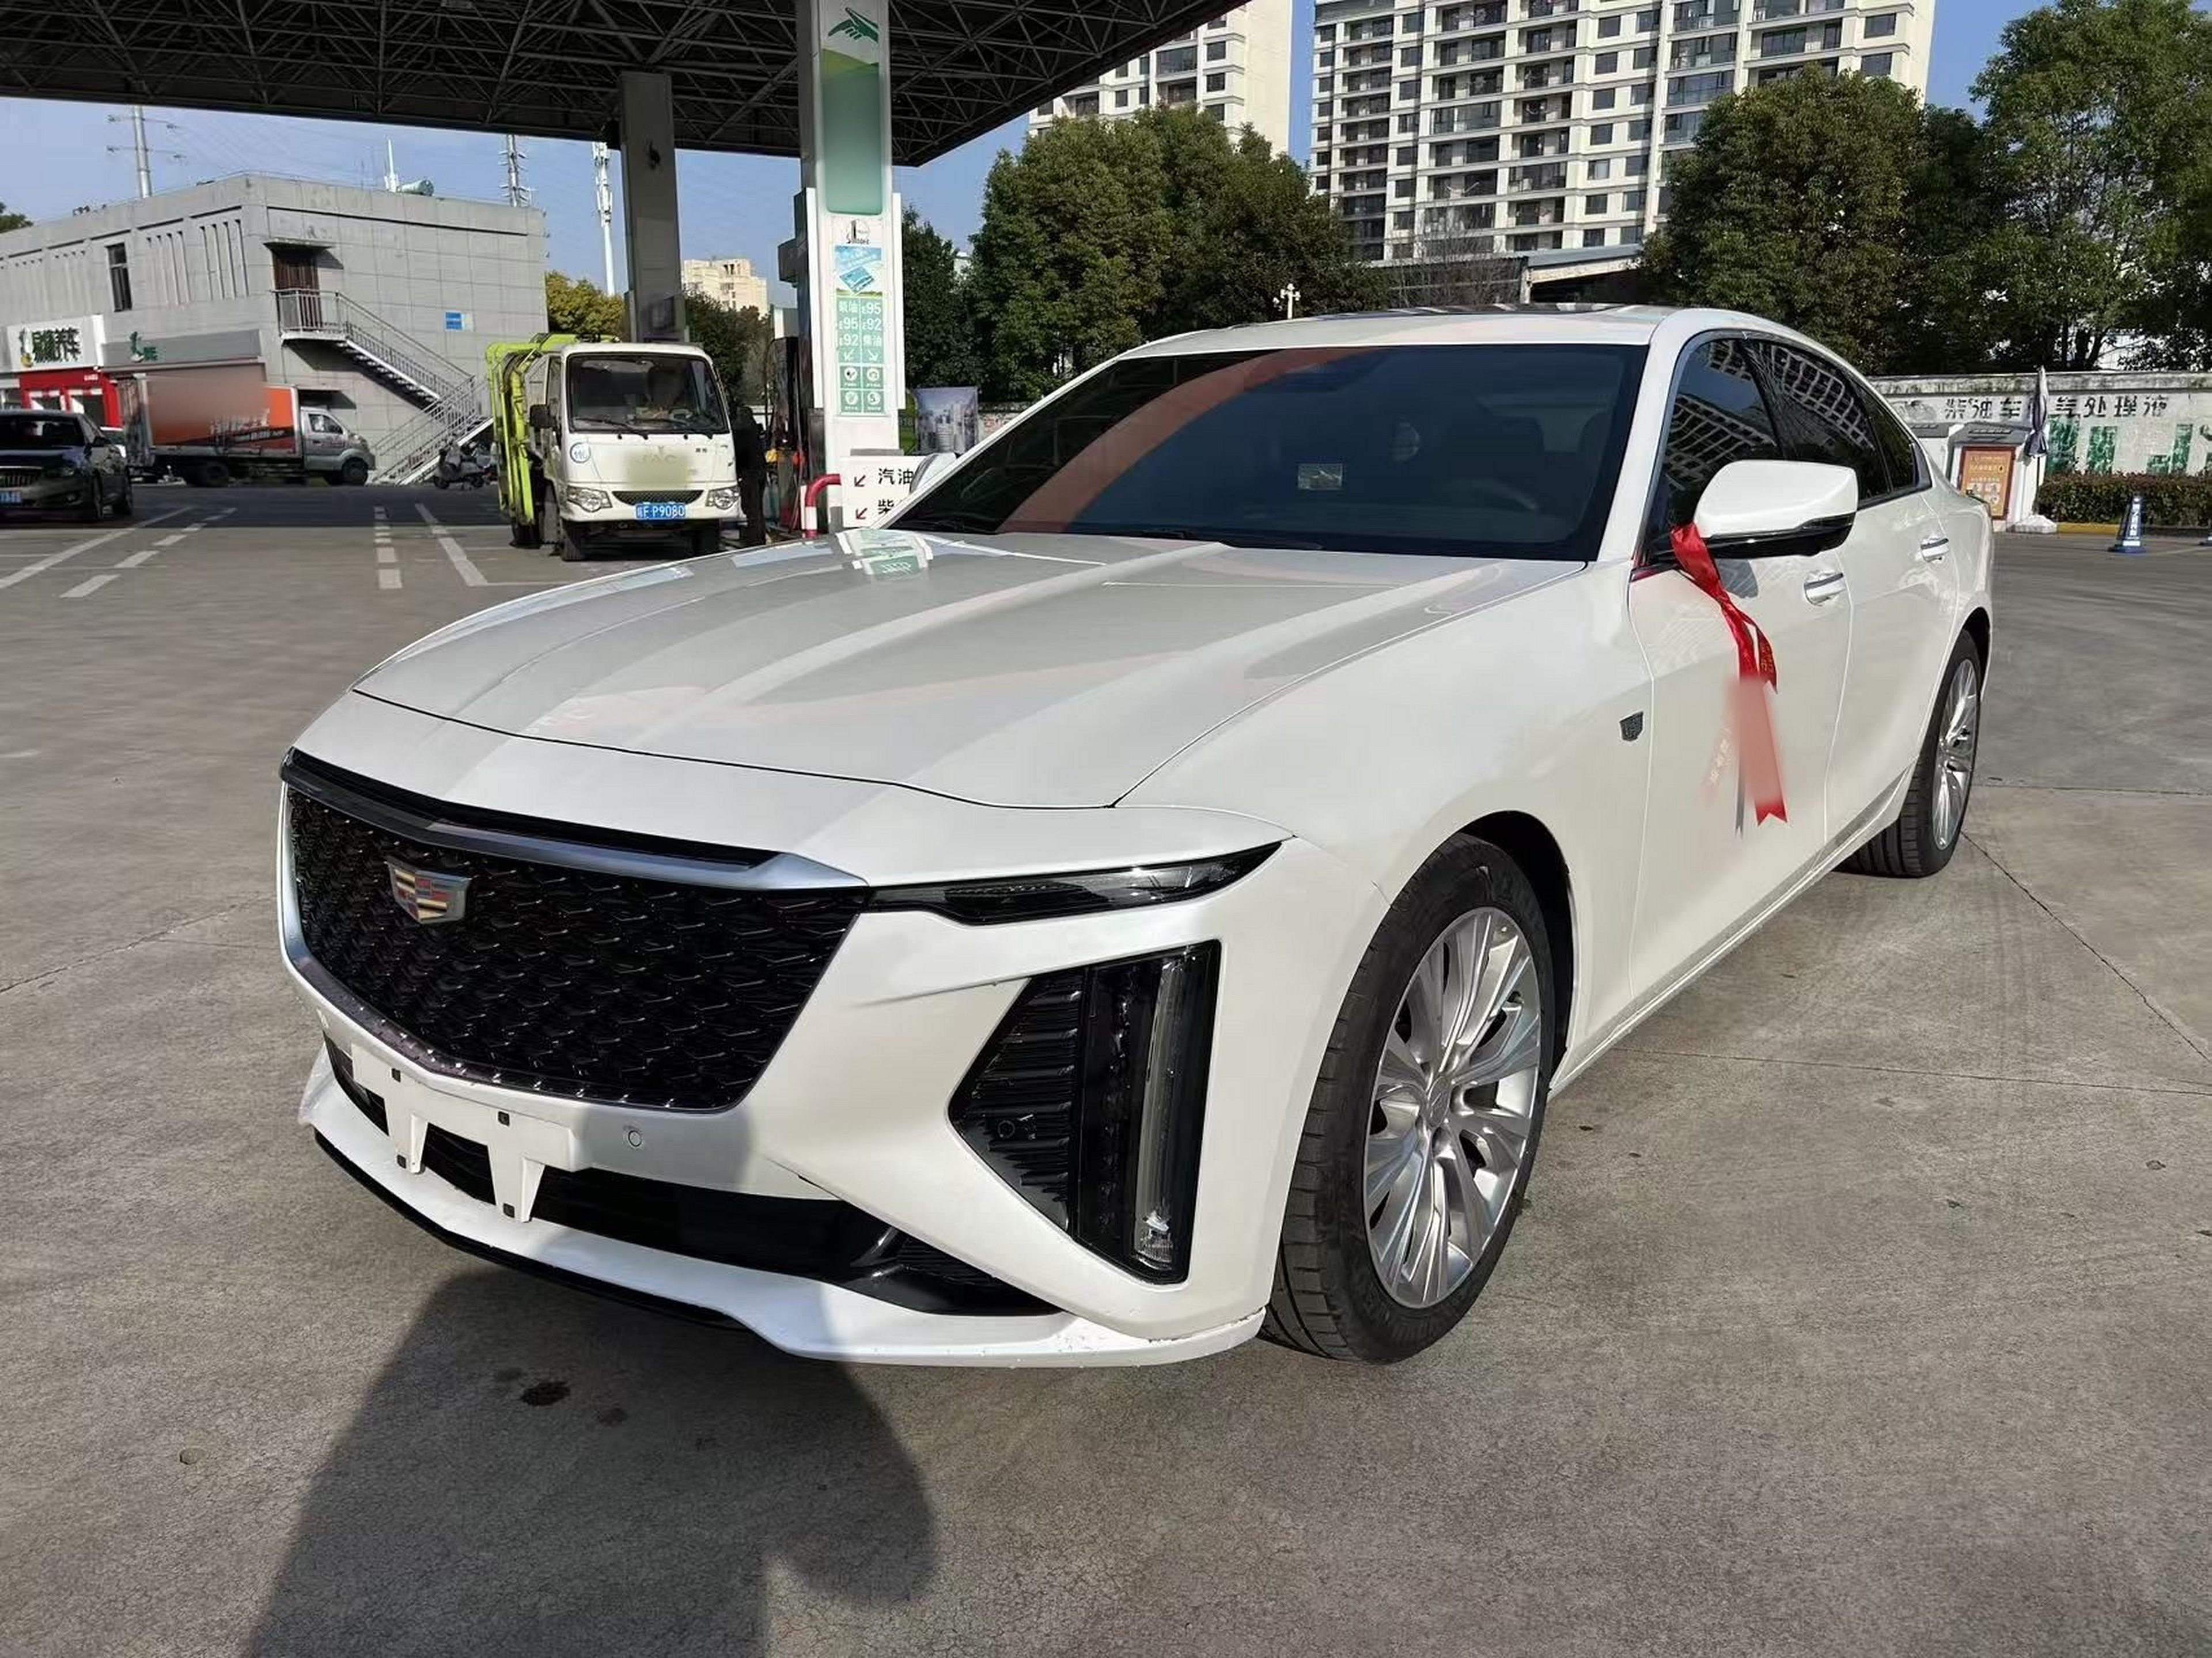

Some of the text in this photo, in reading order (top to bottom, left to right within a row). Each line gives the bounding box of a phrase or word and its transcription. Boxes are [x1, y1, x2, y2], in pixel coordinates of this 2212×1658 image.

[1944, 394, 2168, 419] 柴油车气处理液
[878, 468, 914, 485] 汽油
[878, 498, 896, 515] 柴
